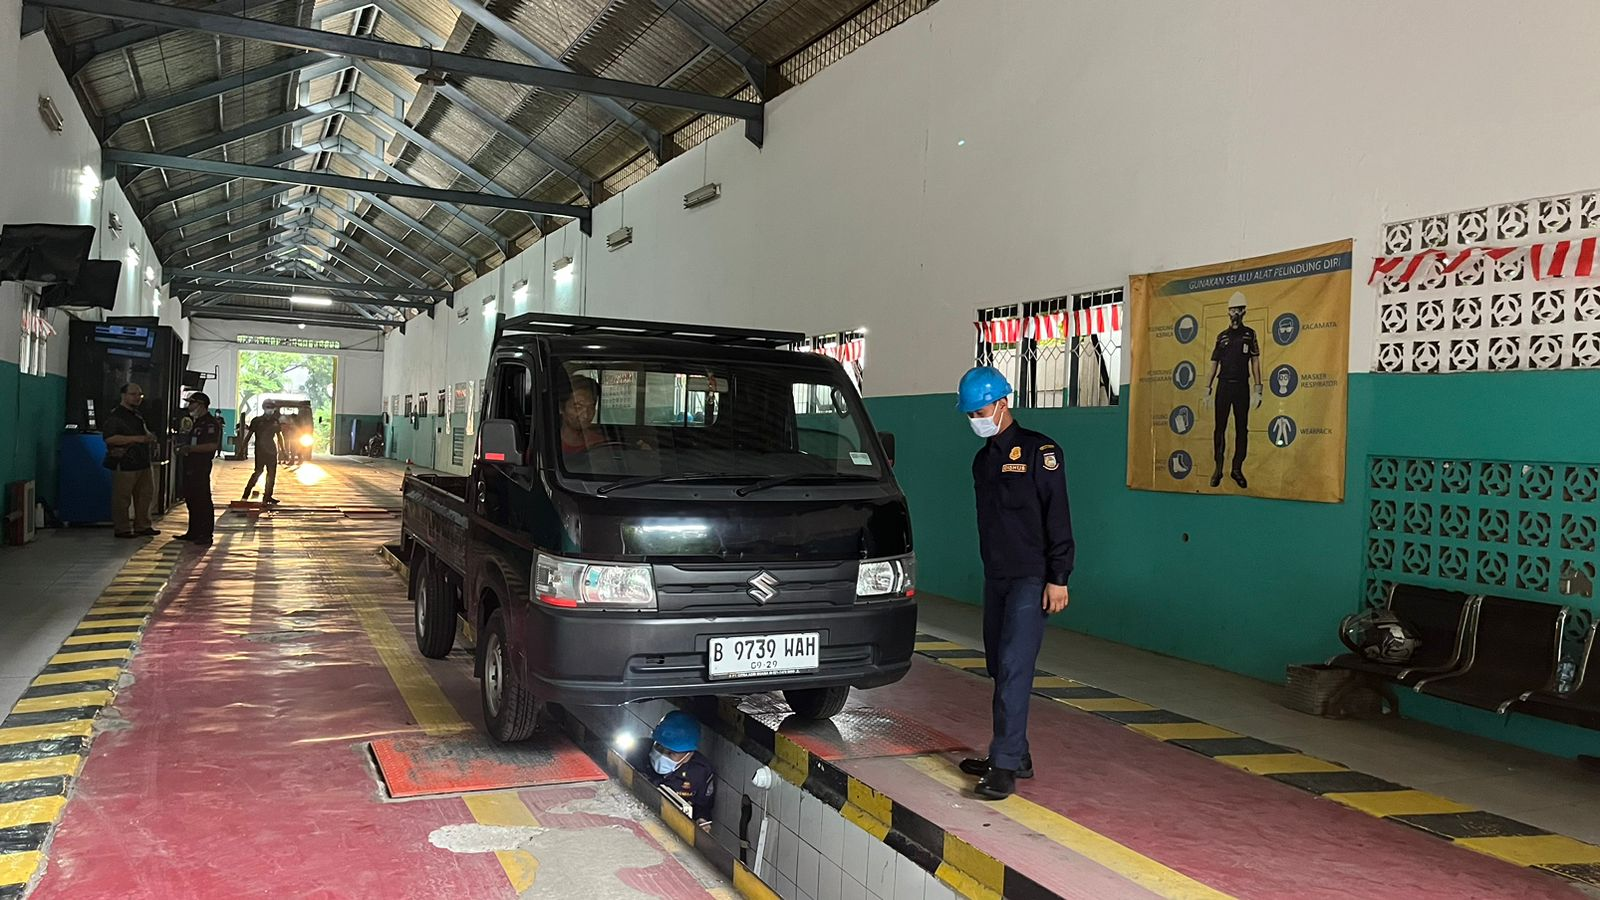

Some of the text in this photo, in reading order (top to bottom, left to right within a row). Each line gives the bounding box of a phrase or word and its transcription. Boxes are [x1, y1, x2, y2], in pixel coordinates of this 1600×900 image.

[1188, 257, 1342, 290] GUNAKAN SELALU ALAT PELINDUNG DIRI
[1302, 321, 1337, 330] KACAMATA
[1301, 380, 1338, 388] RESPIRATOR
[713, 637, 815, 662] B 9739 WAH
